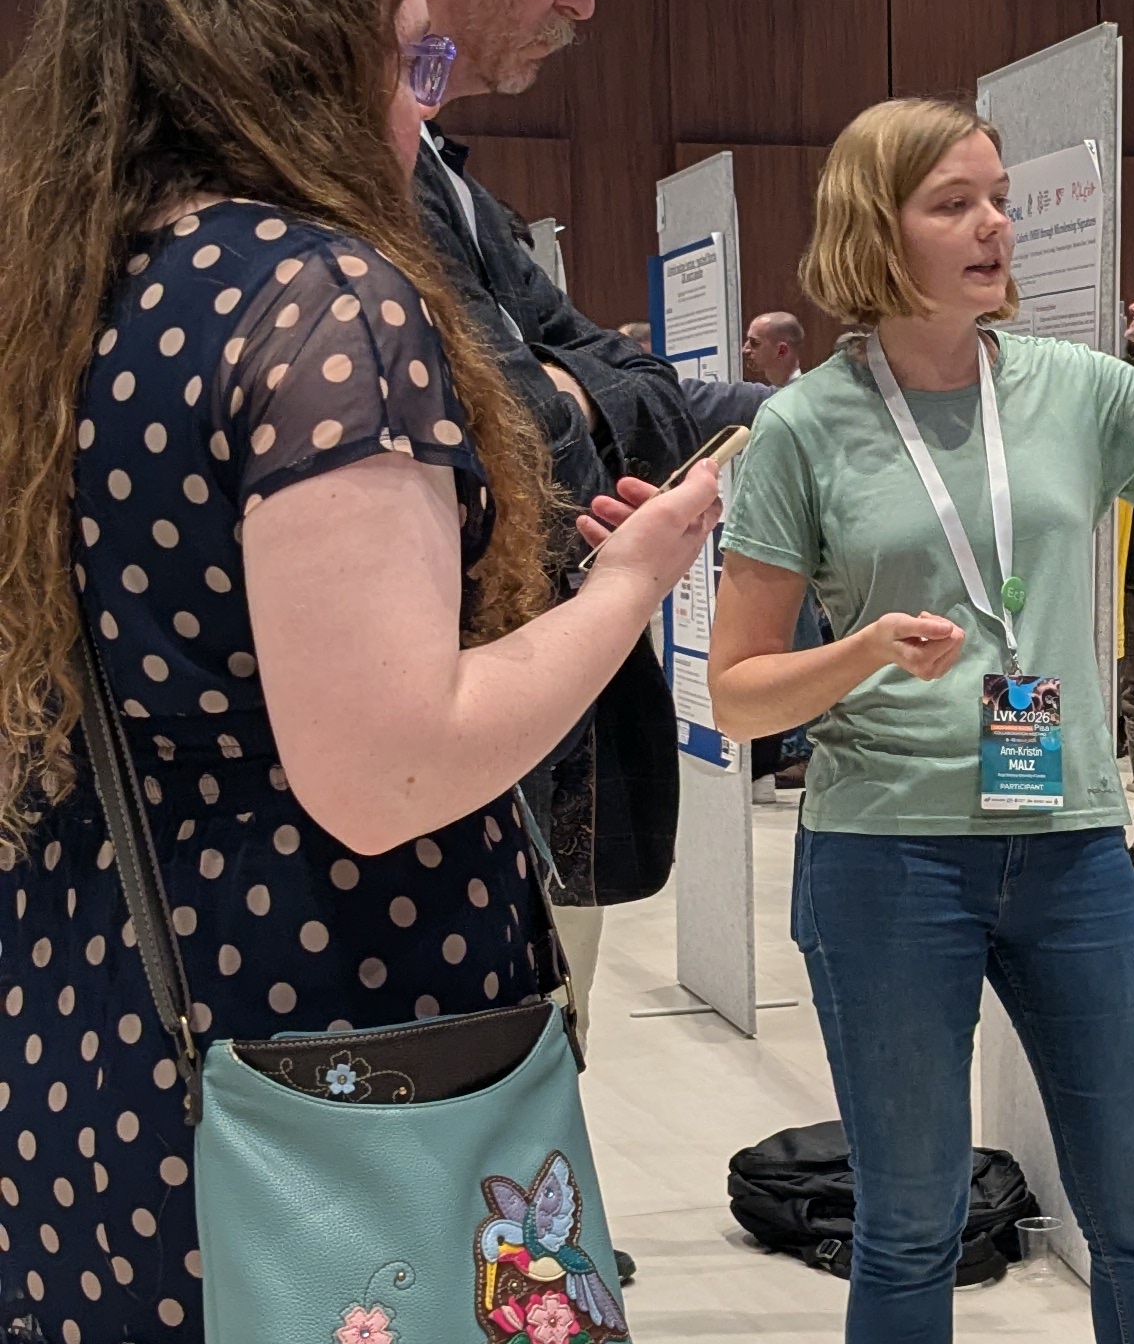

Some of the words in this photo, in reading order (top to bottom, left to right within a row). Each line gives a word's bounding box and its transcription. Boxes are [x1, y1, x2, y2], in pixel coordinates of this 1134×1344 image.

[993, 711, 1017, 722] LVK
[1019, 712, 1050, 723] 2026
[1000, 746, 1042, 756] Ann-Kristin
[1009, 760, 1035, 770] MALZ
